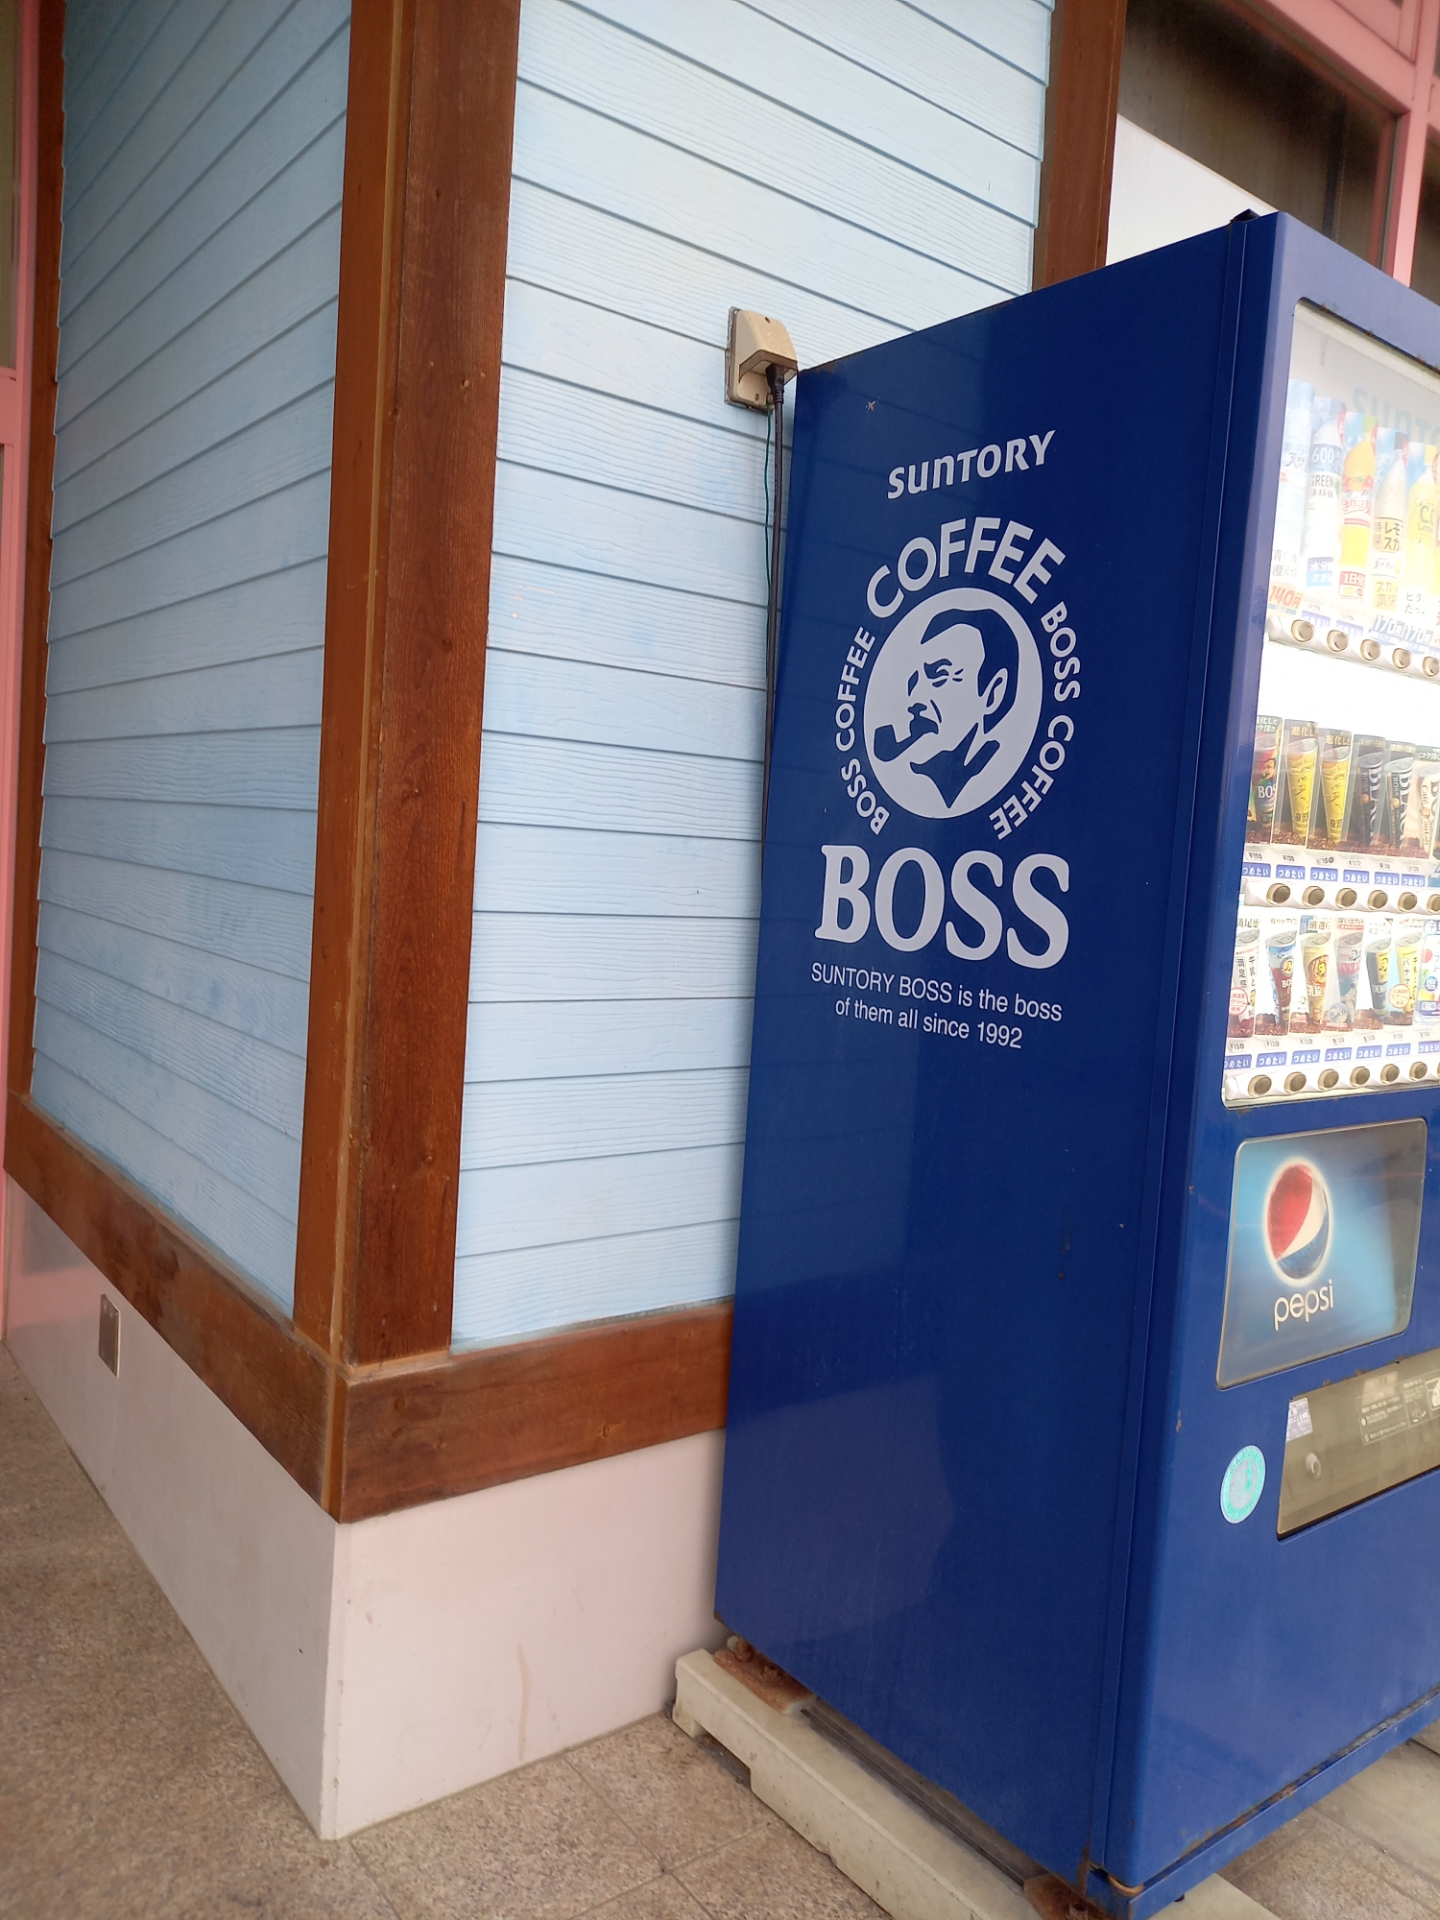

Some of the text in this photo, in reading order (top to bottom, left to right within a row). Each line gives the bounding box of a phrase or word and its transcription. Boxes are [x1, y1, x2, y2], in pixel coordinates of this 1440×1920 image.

[867, 516, 1066, 618] COFFEE
[835, 626, 890, 835] BOSS COFFEE
[989, 601, 1080, 839] BOSS COFFEE
[814, 845, 1070, 969] BOSS
[811, 962, 1062, 1021] SUNTORY BOSS is the boss
[835, 997, 1022, 1048] of them all since 1992
[1259, 1056, 1284, 1067] つめたい
[1294, 1054, 1318, 1064] つめたい
[1327, 1051, 1351, 1061] つめたい
[1274, 1278, 1334, 1331] pepsi
